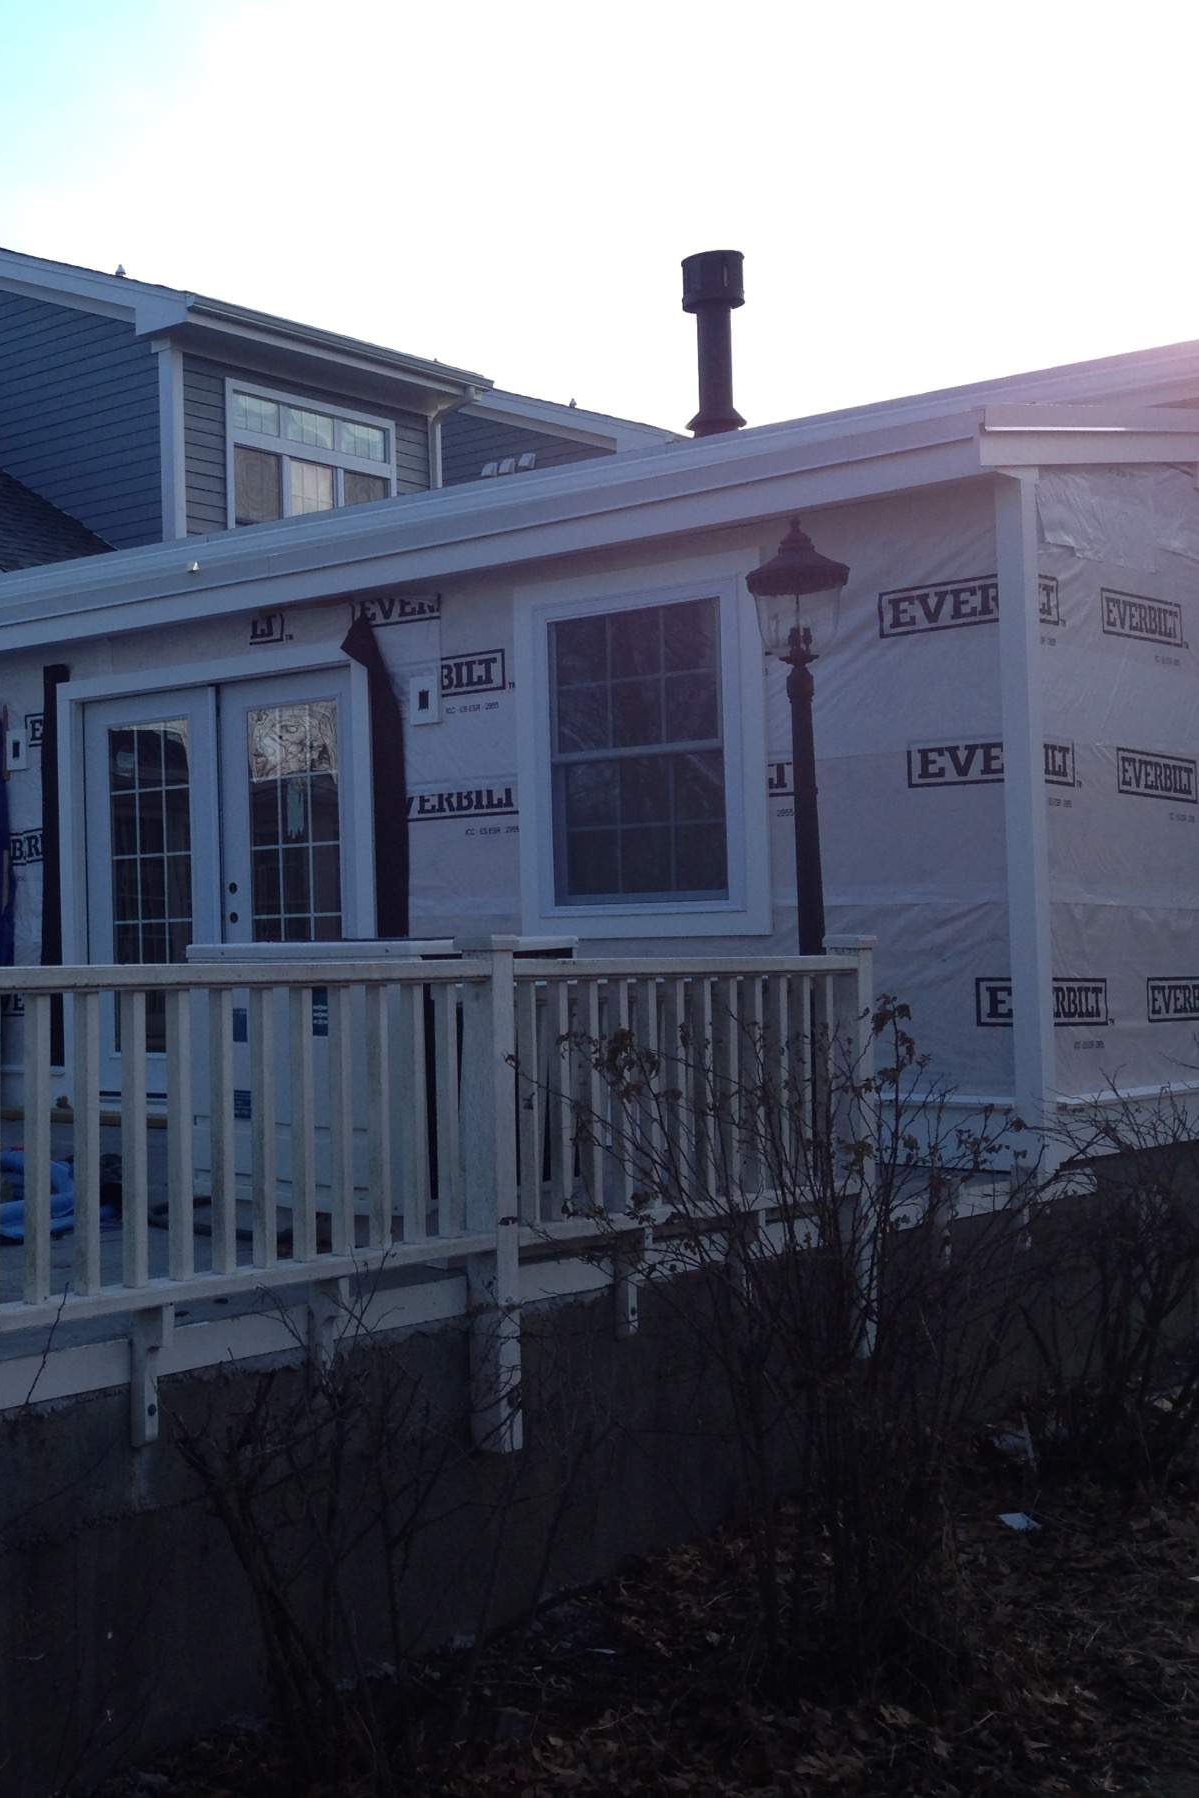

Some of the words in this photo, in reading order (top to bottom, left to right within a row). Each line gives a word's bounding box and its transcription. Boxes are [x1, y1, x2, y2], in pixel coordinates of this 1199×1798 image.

[1104, 597, 1178, 639] EVERBILT
[441, 657, 497, 690] BILT
[1121, 756, 1194, 795] EVERBILT
[1053, 986, 1102, 1018] RBILT
